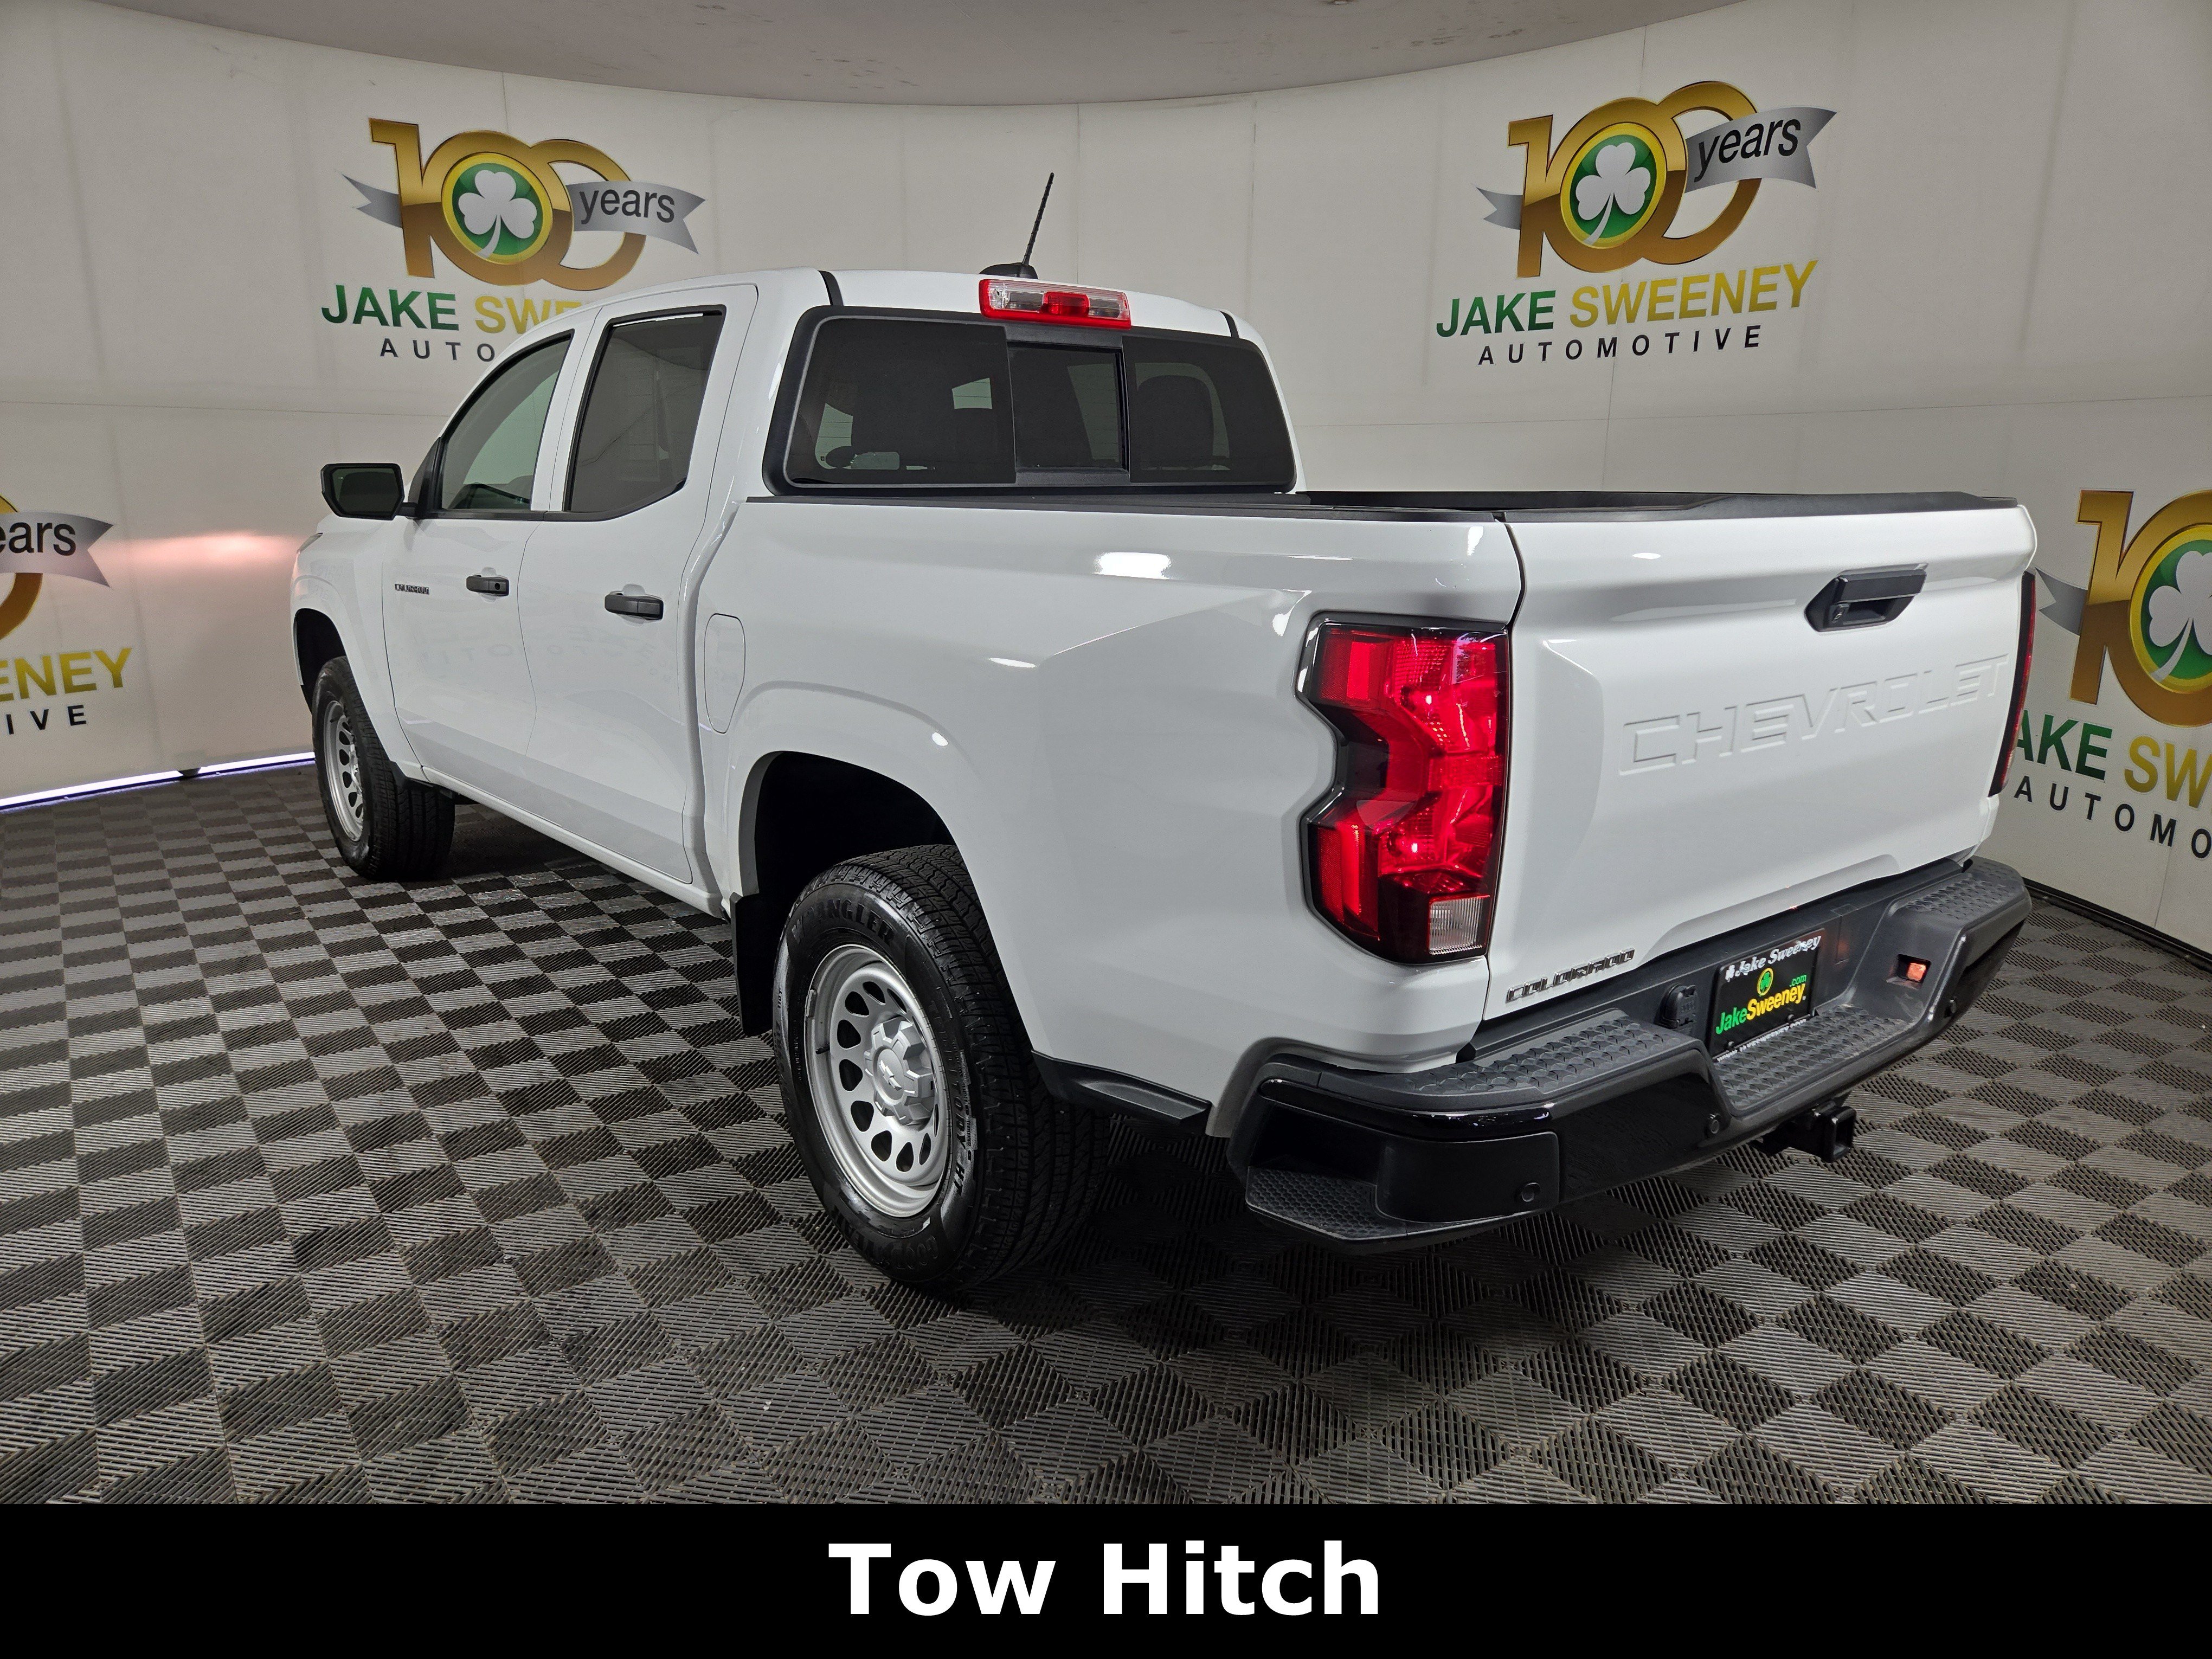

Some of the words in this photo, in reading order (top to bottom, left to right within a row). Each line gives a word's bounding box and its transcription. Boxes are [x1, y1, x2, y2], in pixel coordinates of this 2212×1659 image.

[1693, 118, 1801, 183] years
[580, 187, 676, 224] years
[321, 285, 459, 331] JAKE
[475, 295, 582, 335] SW
[1437, 290, 1556, 337] JAKE
[1570, 260, 1818, 328] SWEENEY
[380, 338, 495, 362] AUTO
[1478, 325, 1761, 365] AUTOMOTIVE
[0, 522, 76, 556] ars
[6, 704, 87, 735] IVE
[1619, 654, 2008, 775] CHEVROLET
[2014, 775, 2212, 859] AUTOMO
[1735, 956, 1766, 976] Jake
[1715, 983, 1805, 1034] JakeSweeney
